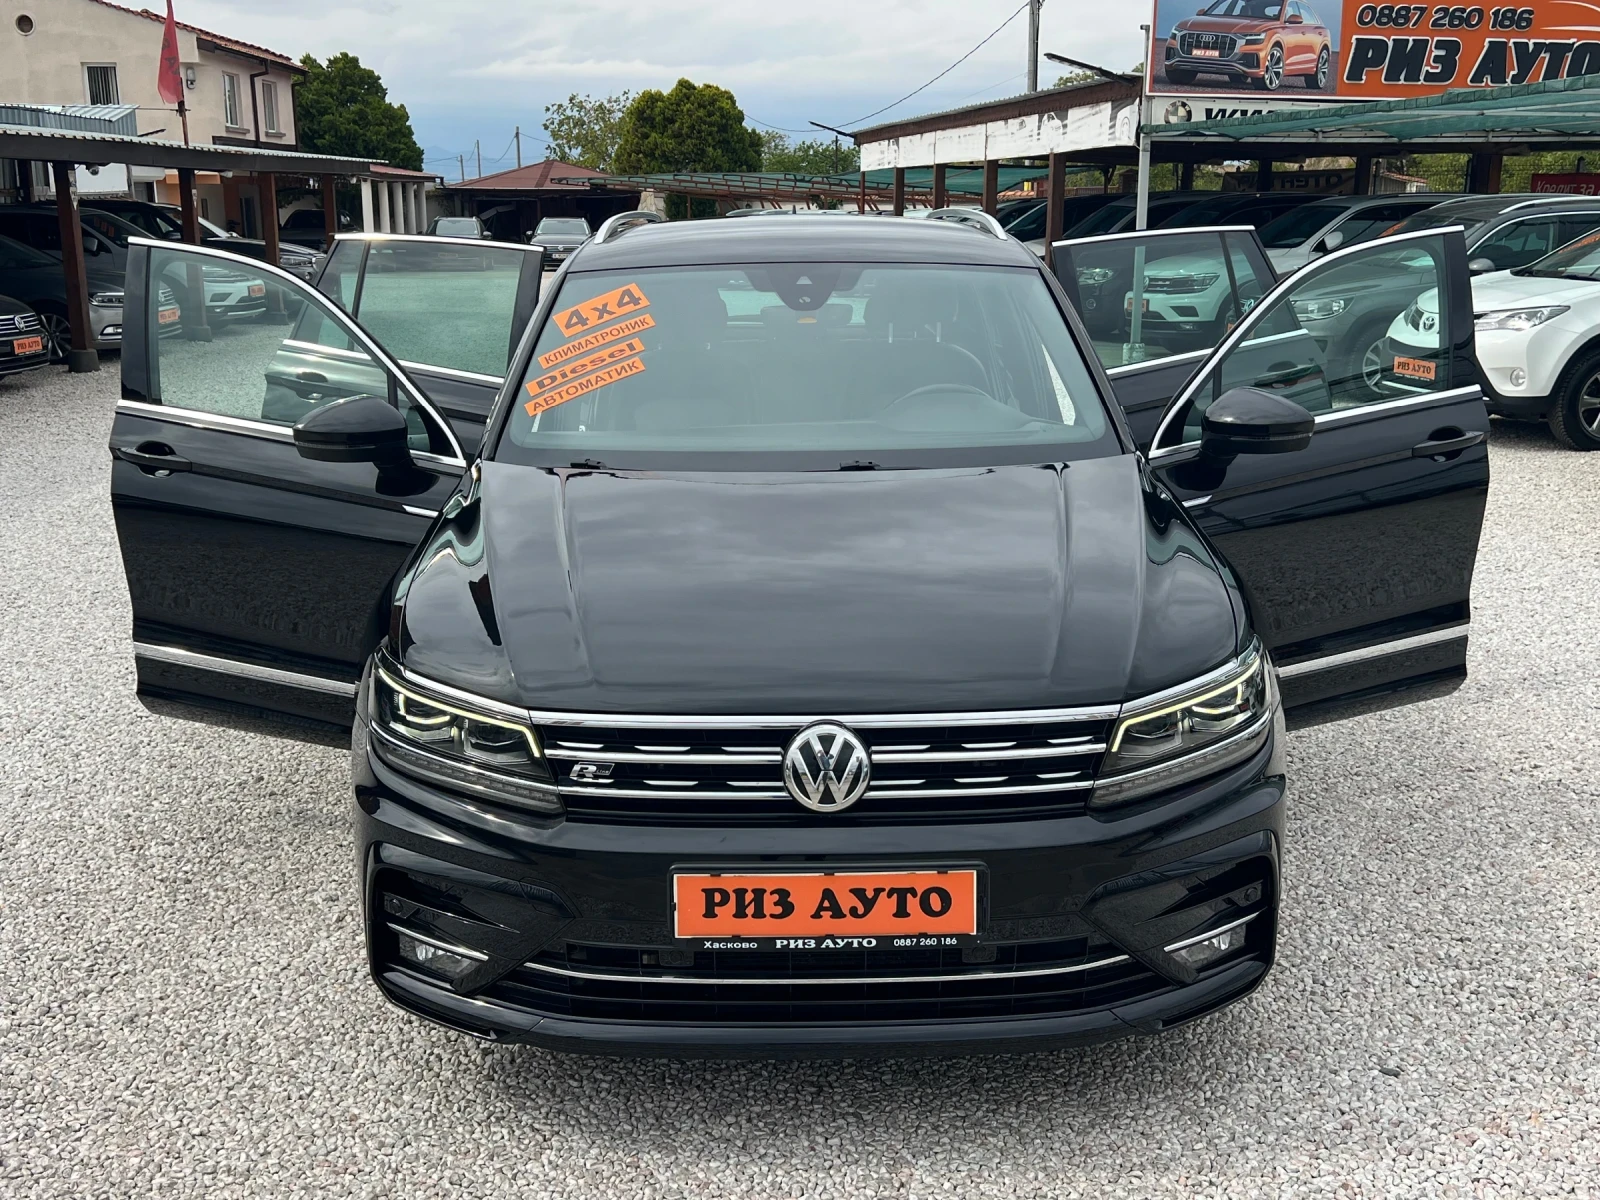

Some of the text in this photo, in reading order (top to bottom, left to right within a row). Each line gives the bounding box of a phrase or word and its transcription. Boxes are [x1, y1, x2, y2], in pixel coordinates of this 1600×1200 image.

[1357, 4, 1534, 30] 0887 260 186
[1344, 35, 1600, 86] РИЗ АУТО
[544, 317, 650, 364] КЛИМАТРОНИК
[536, 342, 636, 389] Diesel
[1397, 361, 1431, 374] РИЗ АУТО
[533, 361, 639, 411] АВТОМАТИК
[701, 886, 953, 919] РИЗ АУТО
[703, 937, 957, 949] Хасково РИЗ АУТО 0887 260 186
